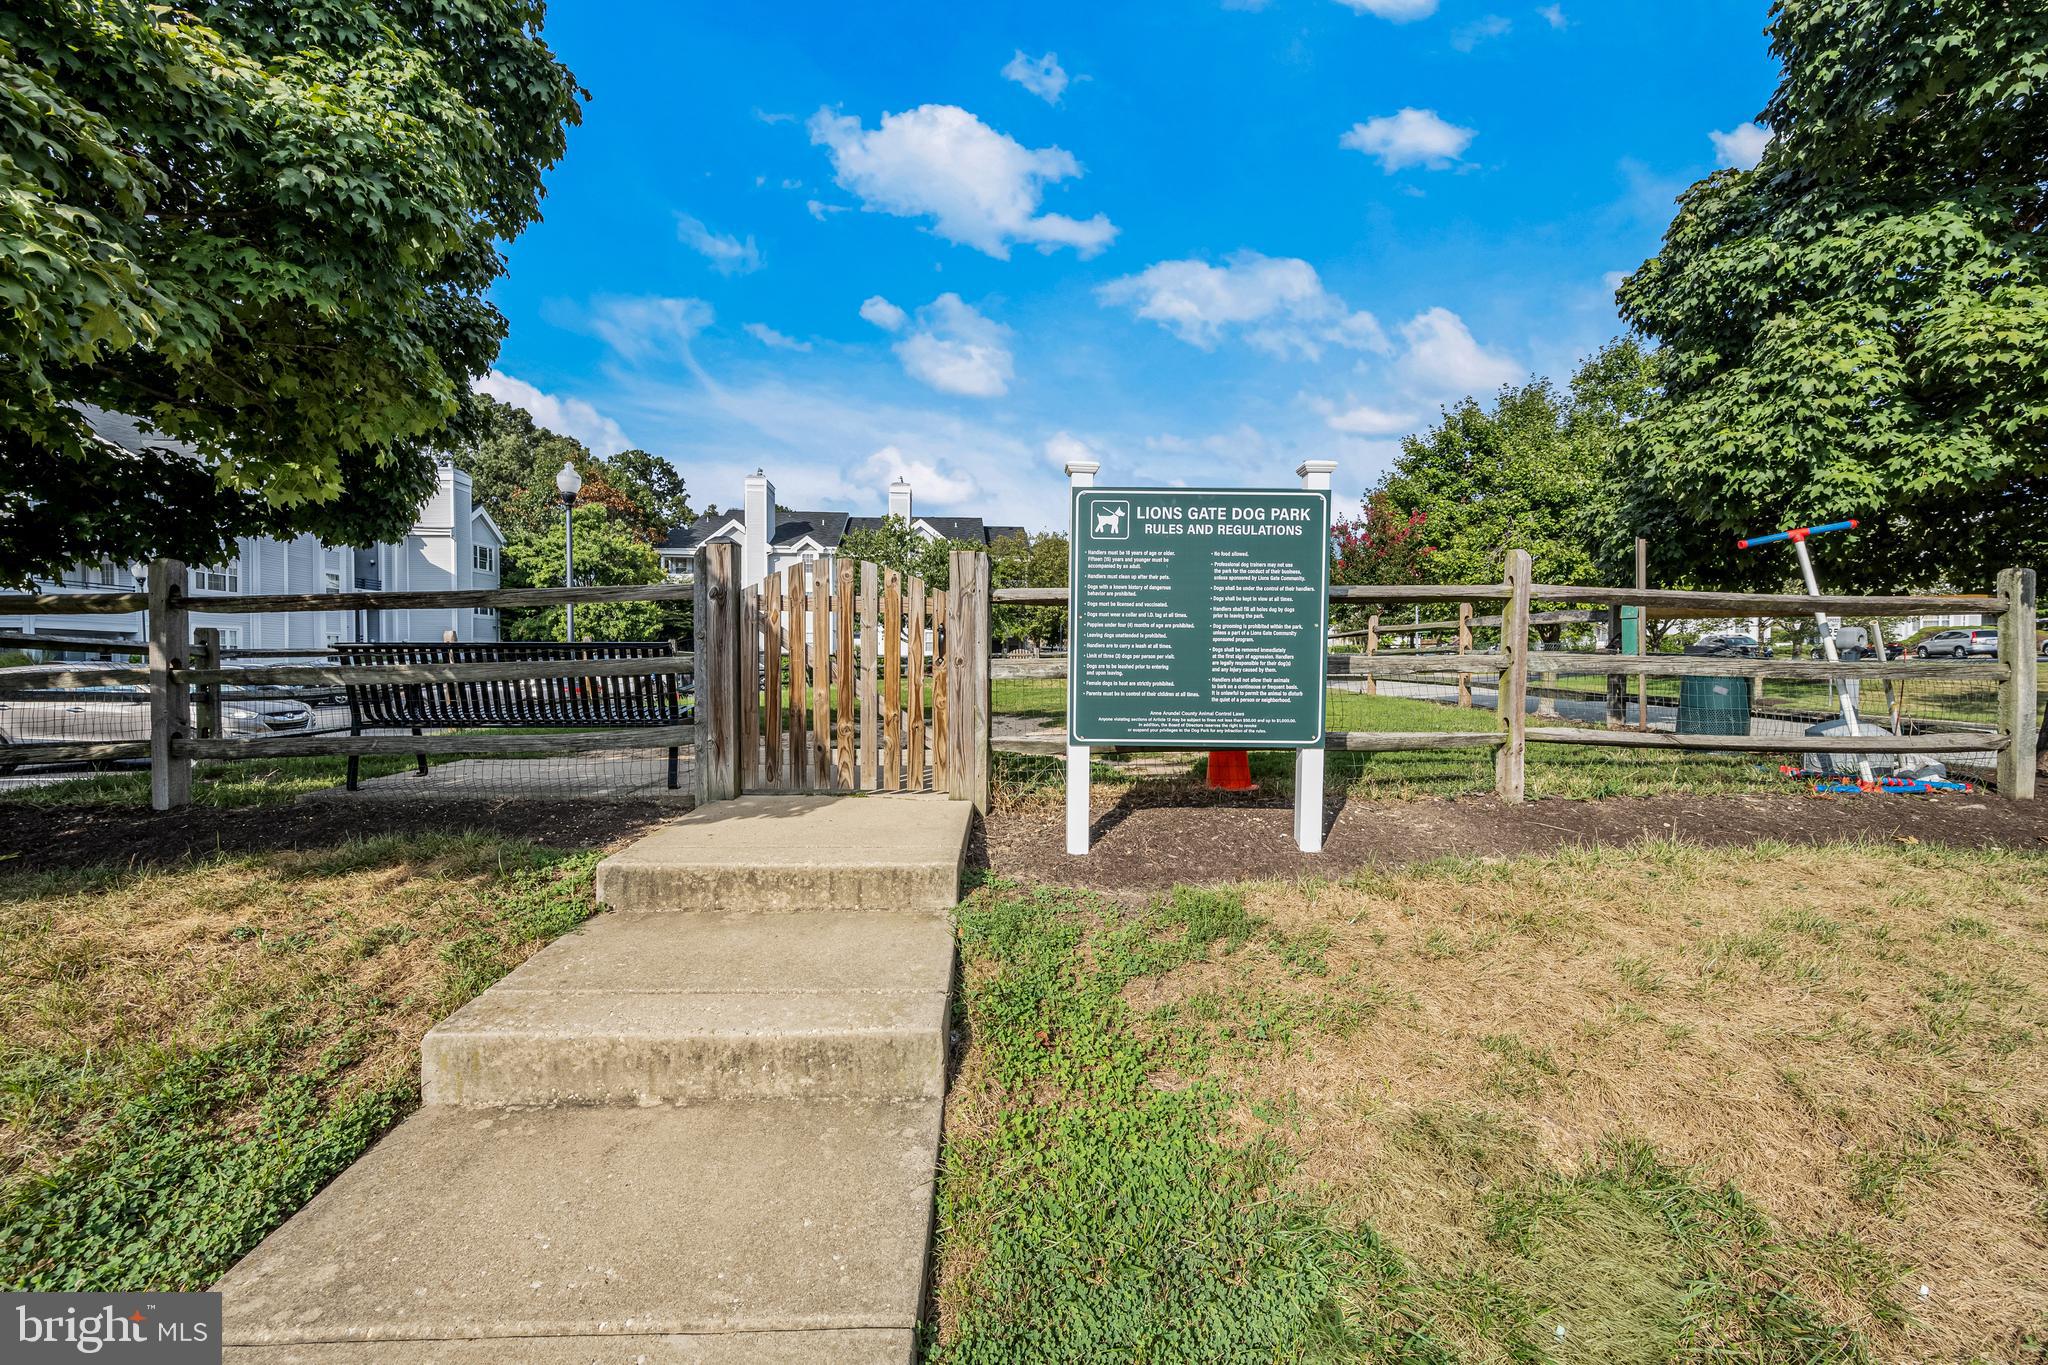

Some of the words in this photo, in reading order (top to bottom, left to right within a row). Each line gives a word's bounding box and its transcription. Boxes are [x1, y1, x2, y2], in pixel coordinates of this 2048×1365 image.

[1137, 507, 1183, 520] LIONS
[1188, 507, 1227, 520] GATE
[1232, 508, 1265, 520] DOG
[1270, 508, 1310, 521] PARK
[1145, 524, 1183, 534] RULES
[1187, 524, 1213, 534] AND
[1217, 524, 1302, 535] REGULATIONS
